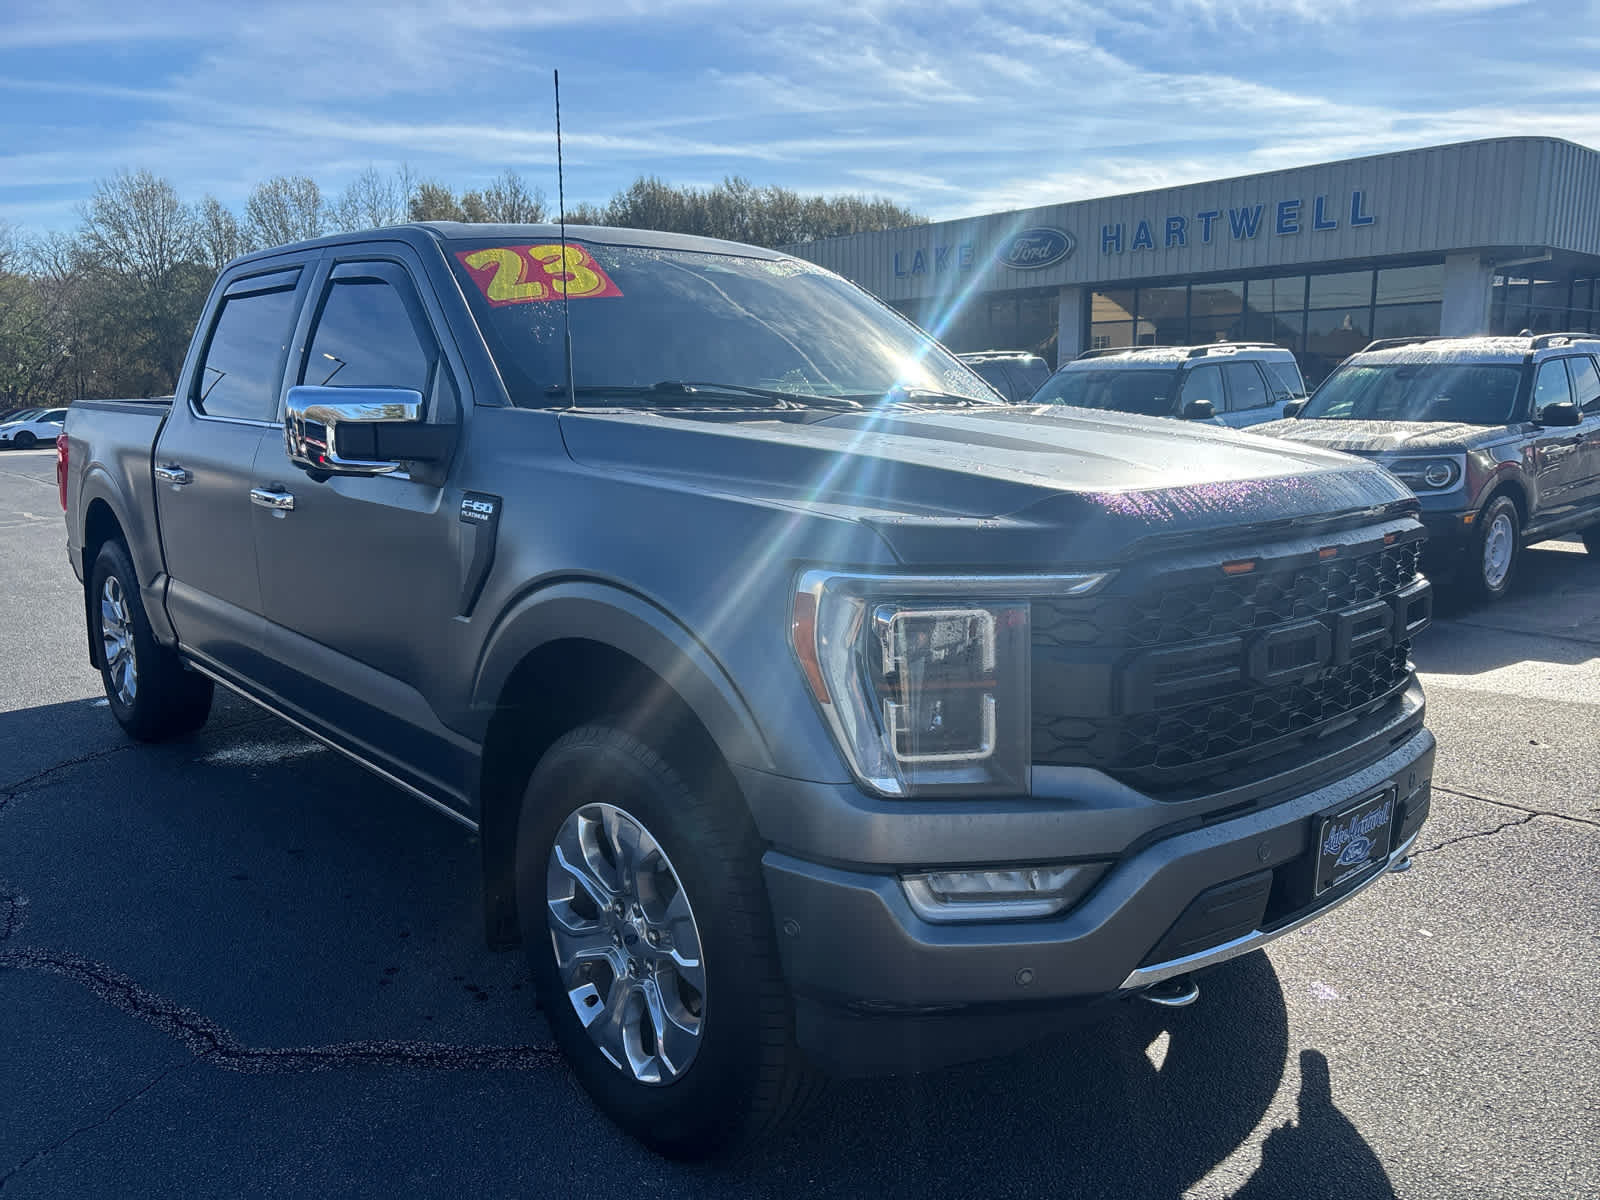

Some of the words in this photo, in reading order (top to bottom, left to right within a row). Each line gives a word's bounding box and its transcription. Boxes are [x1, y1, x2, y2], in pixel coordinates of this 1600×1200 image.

[895, 245, 975, 277] LAKE
[1101, 191, 1375, 254] HARTWELL
[1009, 239, 1053, 262] Ford
[464, 244, 606, 302] 23
[1120, 577, 1433, 718] FORD
